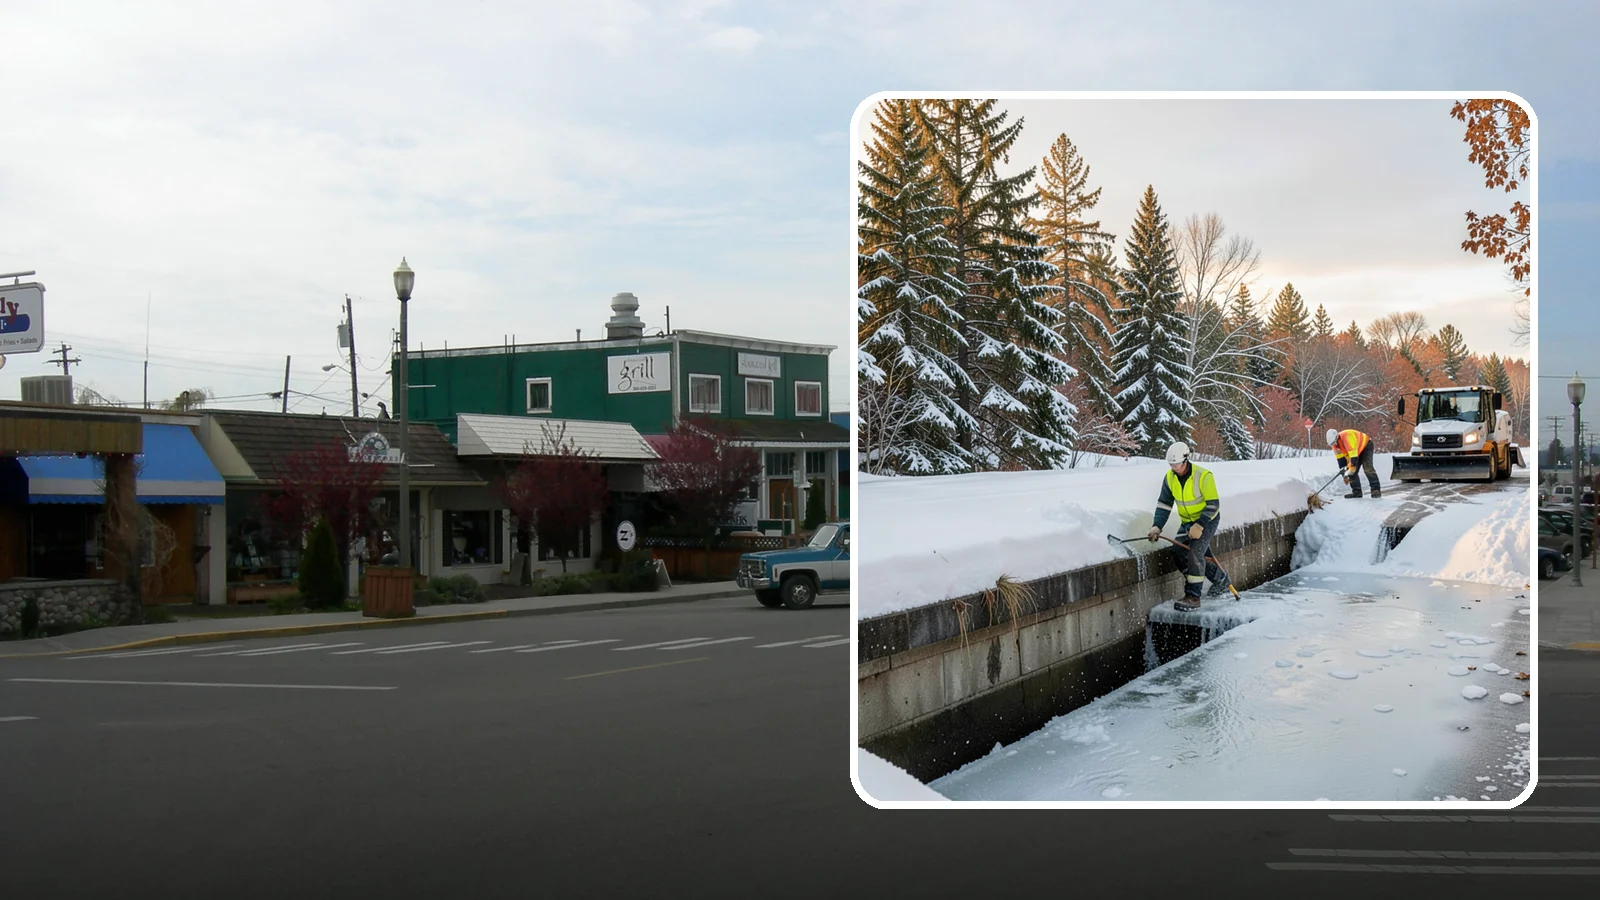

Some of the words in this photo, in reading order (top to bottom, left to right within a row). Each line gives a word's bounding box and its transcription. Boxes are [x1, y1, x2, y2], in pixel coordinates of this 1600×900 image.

[0, 296, 19, 324] ly
[20, 337, 38, 345] Salads
[617, 356, 655, 391] grill
